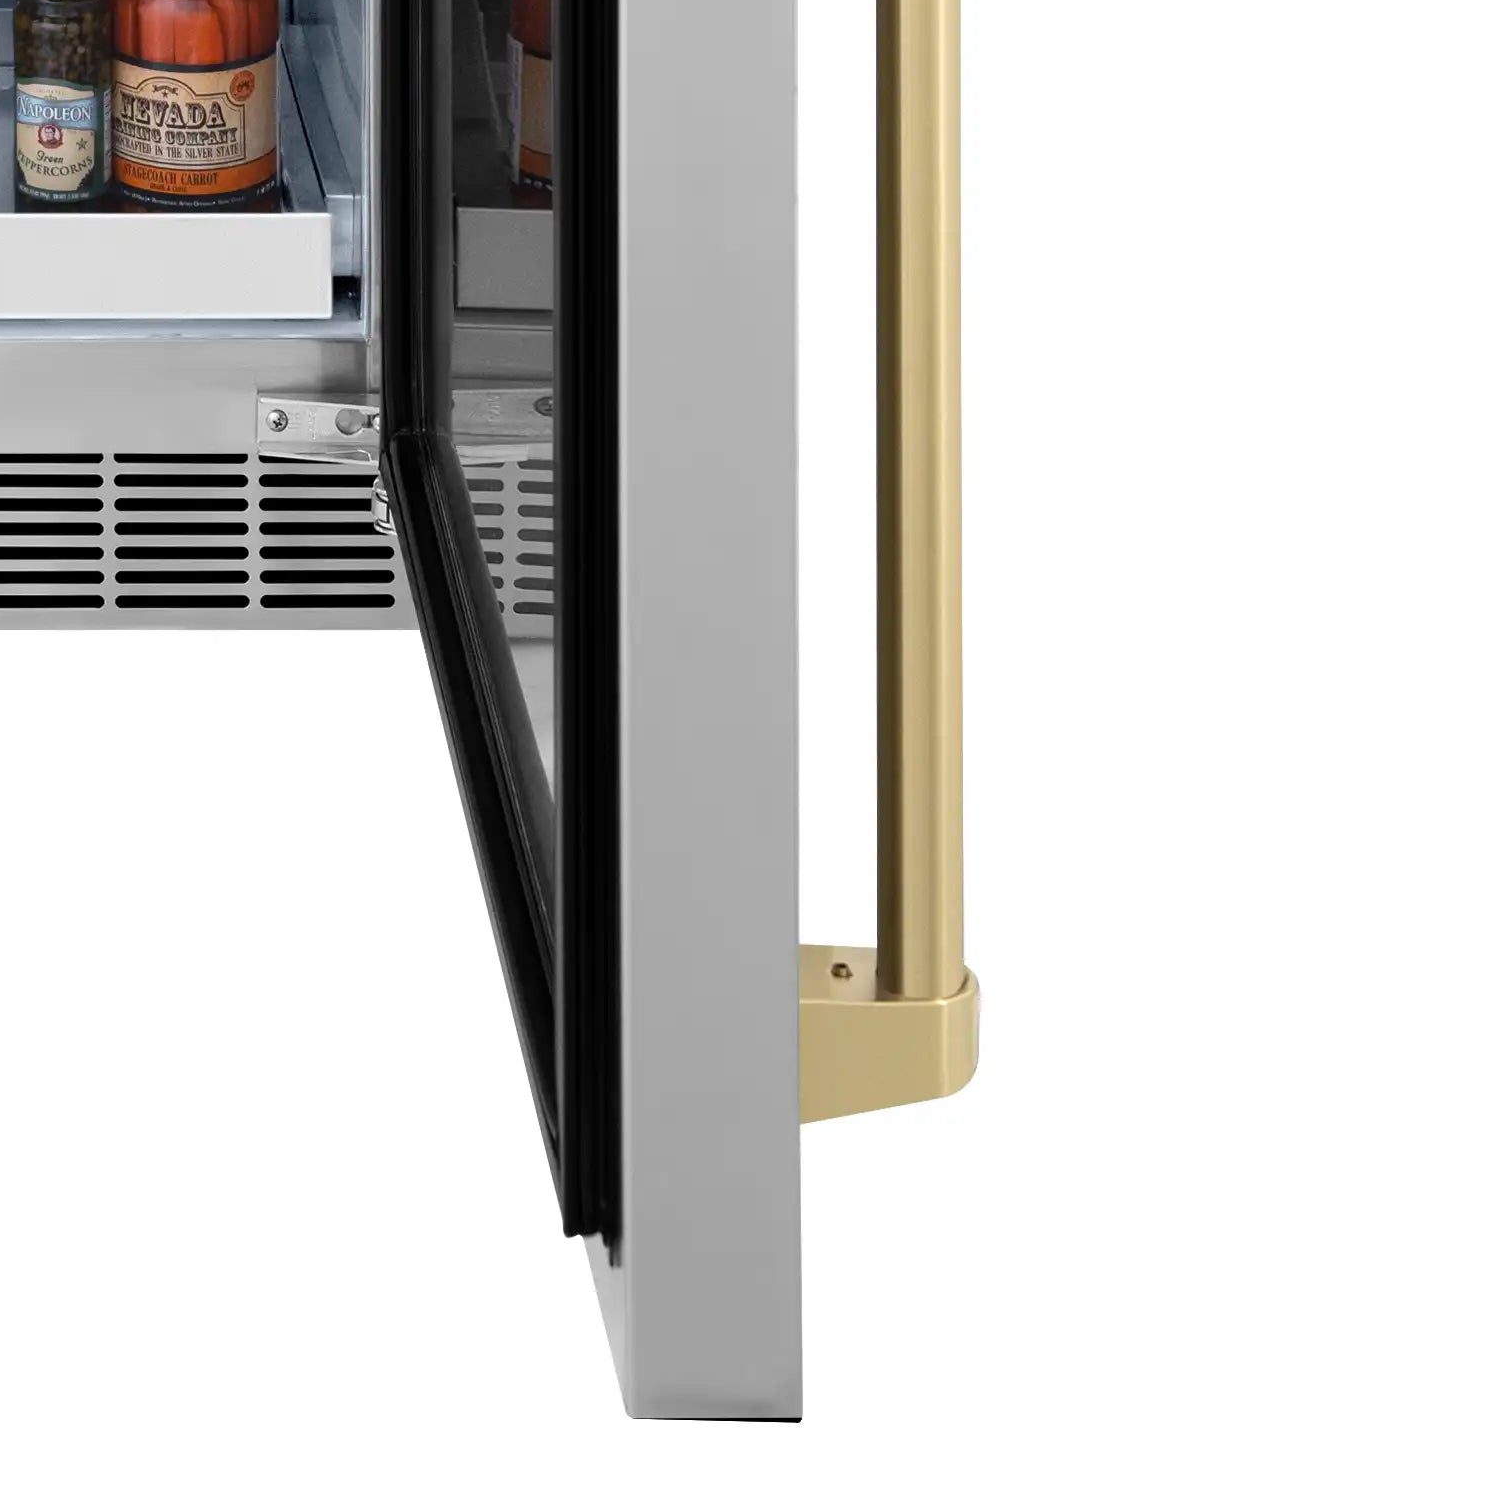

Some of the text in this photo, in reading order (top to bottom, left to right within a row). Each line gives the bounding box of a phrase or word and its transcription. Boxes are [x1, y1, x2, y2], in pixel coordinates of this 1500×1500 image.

[17, 95, 91, 121] NAPOLEON
[119, 89, 226, 129] NEVADA
[164, 128, 238, 146] COMPANY
[36, 150, 64, 164] Green
[155, 145, 163, 156] IN
[166, 146, 182, 158] THE
[185, 146, 213, 159] SILVER
[216, 143, 239, 157] STATE
[122, 163, 218, 186] STAGECOACH CARROT
